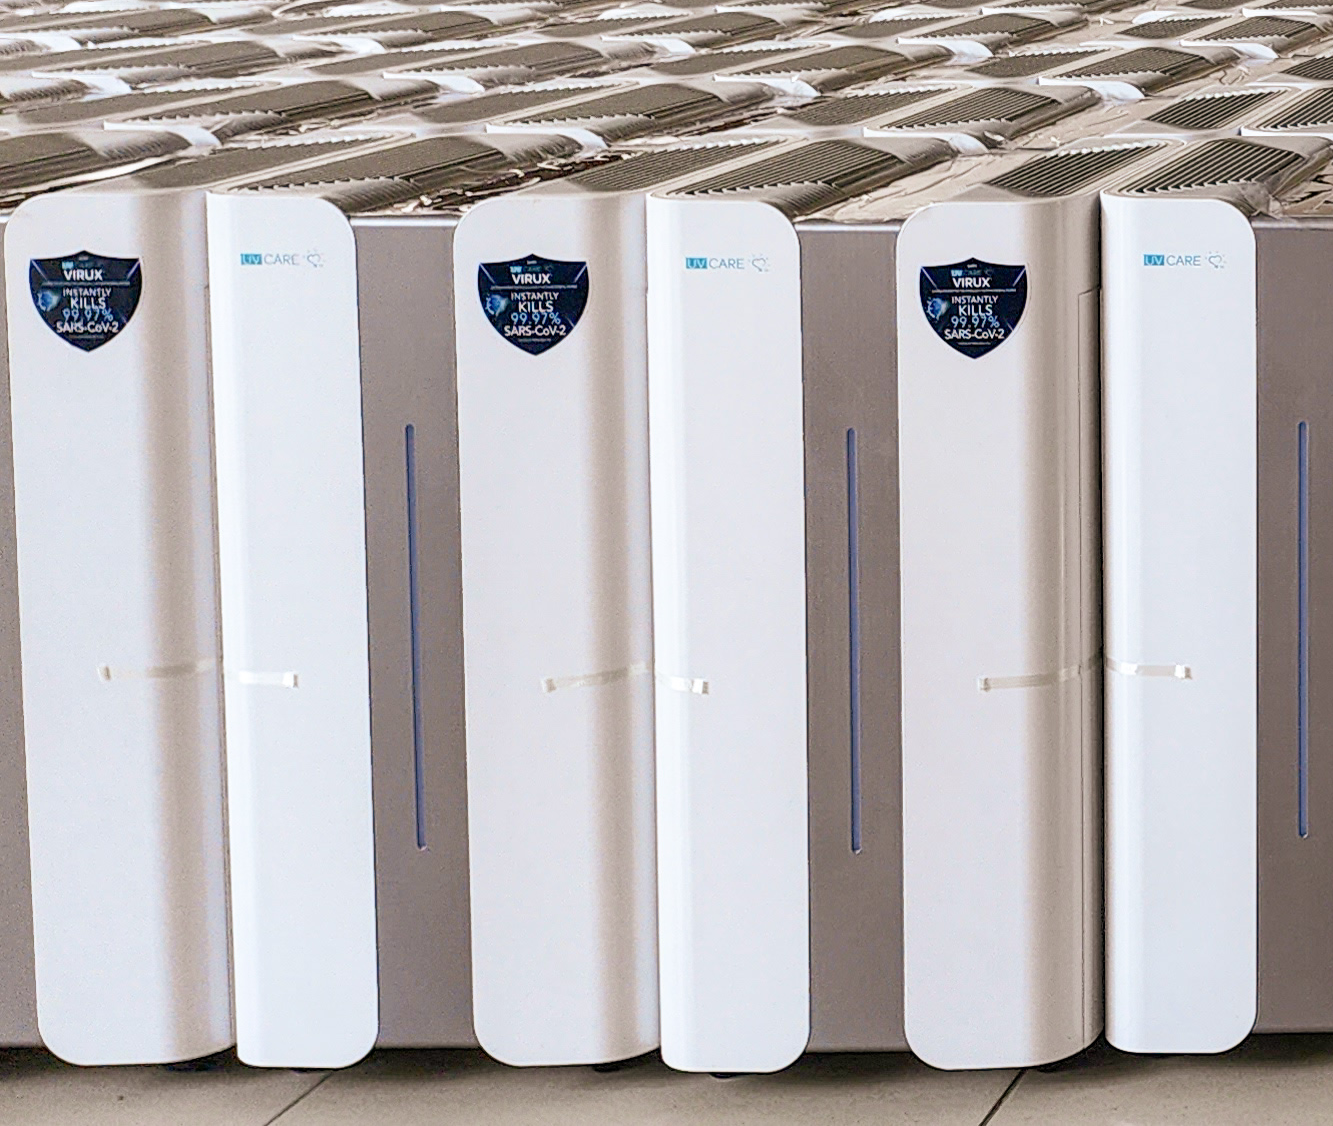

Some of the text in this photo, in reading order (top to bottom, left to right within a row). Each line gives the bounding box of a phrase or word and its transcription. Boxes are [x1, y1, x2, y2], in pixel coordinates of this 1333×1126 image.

[241, 254, 300, 265] UV CARE
[686, 258, 744, 269] UV CARE
[1144, 254, 1201, 266] UV CARE
[64, 269, 103, 280] VIRUX
[512, 274, 551, 284] VIRUX
[953, 277, 990, 287] VIRUX
[63, 288, 111, 296] INSTANTLY
[511, 292, 559, 300] INSTANTLY
[71, 297, 106, 309] KILLS
[952, 296, 999, 304] INSTANTLY
[519, 301, 553, 312] KILLS
[959, 305, 992, 316] KILLS
[511, 312, 560, 325] 99.97%
[951, 316, 1000, 328] 99.97%
[56, 322, 119, 333] SARS-CoV-2
[504, 325, 566, 336] SARS-CoV-2
[944, 329, 1005, 339] SARS-CoV-2
